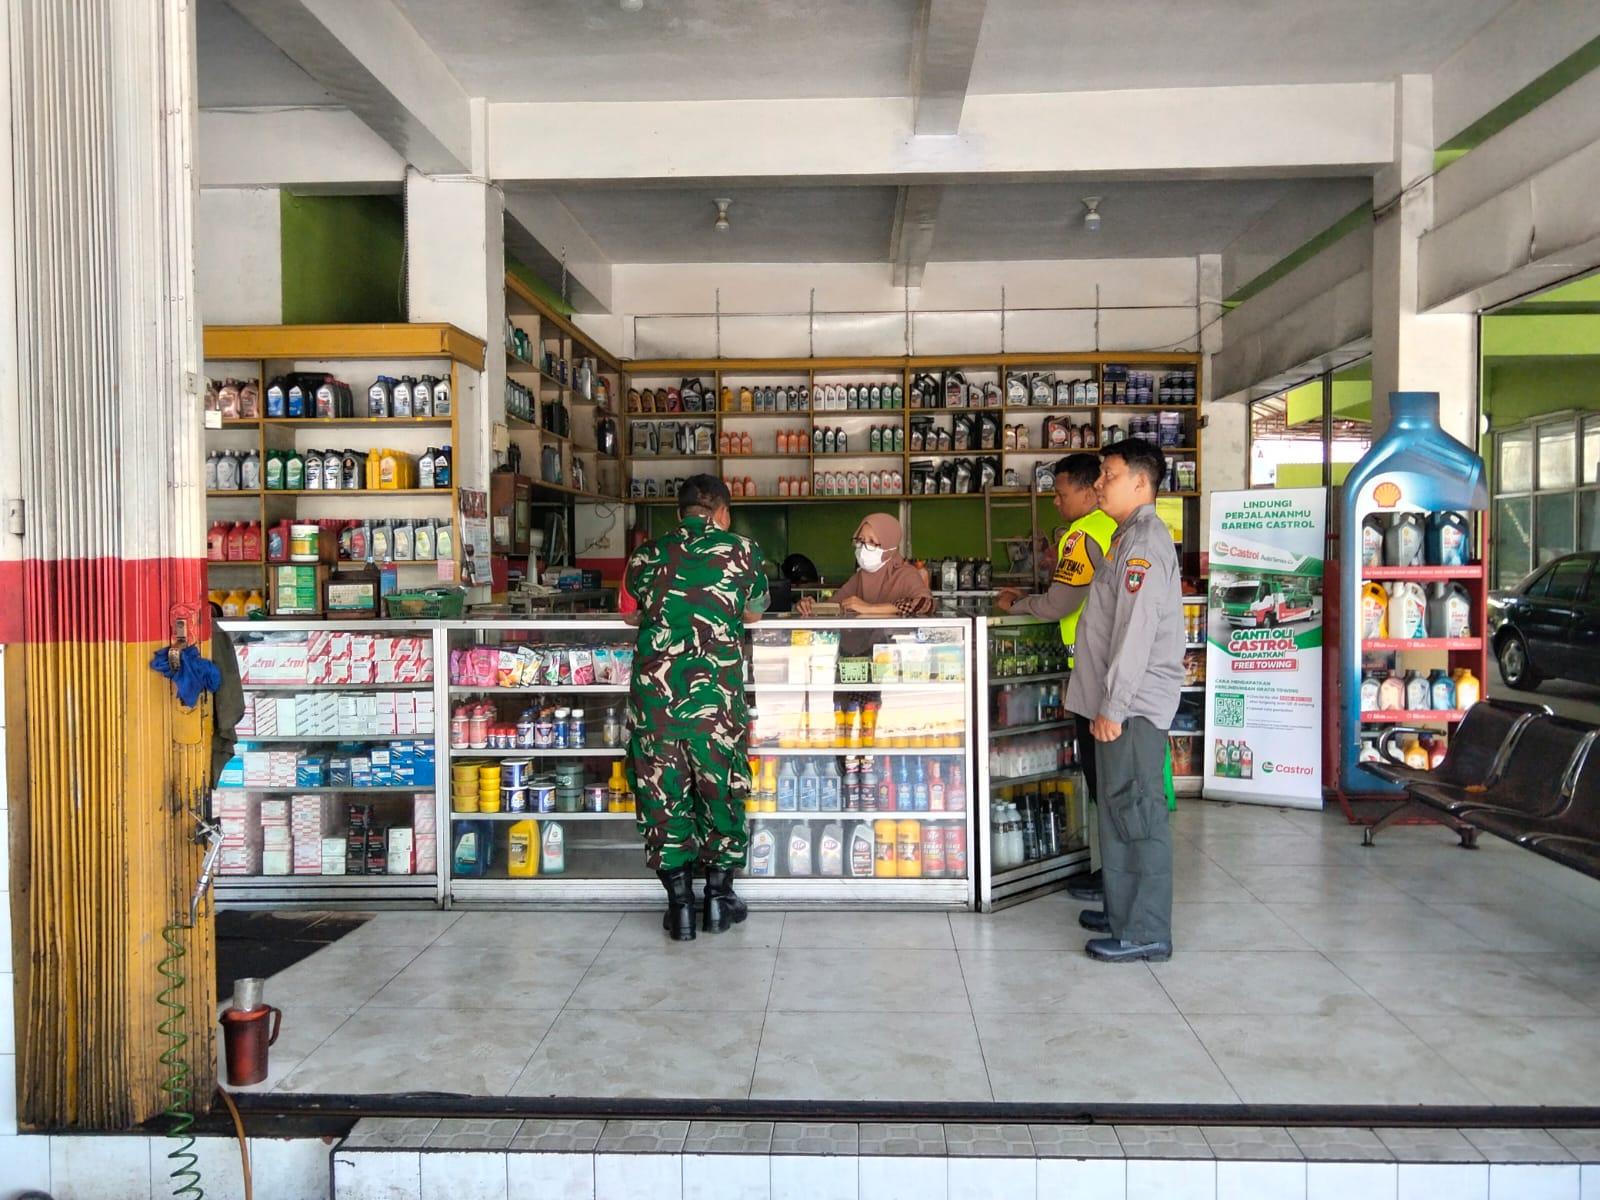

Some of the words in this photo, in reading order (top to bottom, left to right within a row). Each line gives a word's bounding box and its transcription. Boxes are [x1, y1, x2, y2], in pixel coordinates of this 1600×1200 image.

[1243, 499, 1292, 509] LINDUNGI
[1225, 510, 1311, 519] PERJALANANMU
[1221, 520, 1263, 530] BARENG
[1266, 520, 1315, 529] CASTROL
[1229, 546, 1260, 560] Castrol
[1232, 629, 1270, 641] GANTI
[1272, 628, 1293, 640] OLI
[1230, 639, 1296, 651] CASTROL
[1234, 661, 1255, 670] FREE
[1257, 660, 1292, 669] TOWING
[1275, 763, 1314, 776] Castrol
